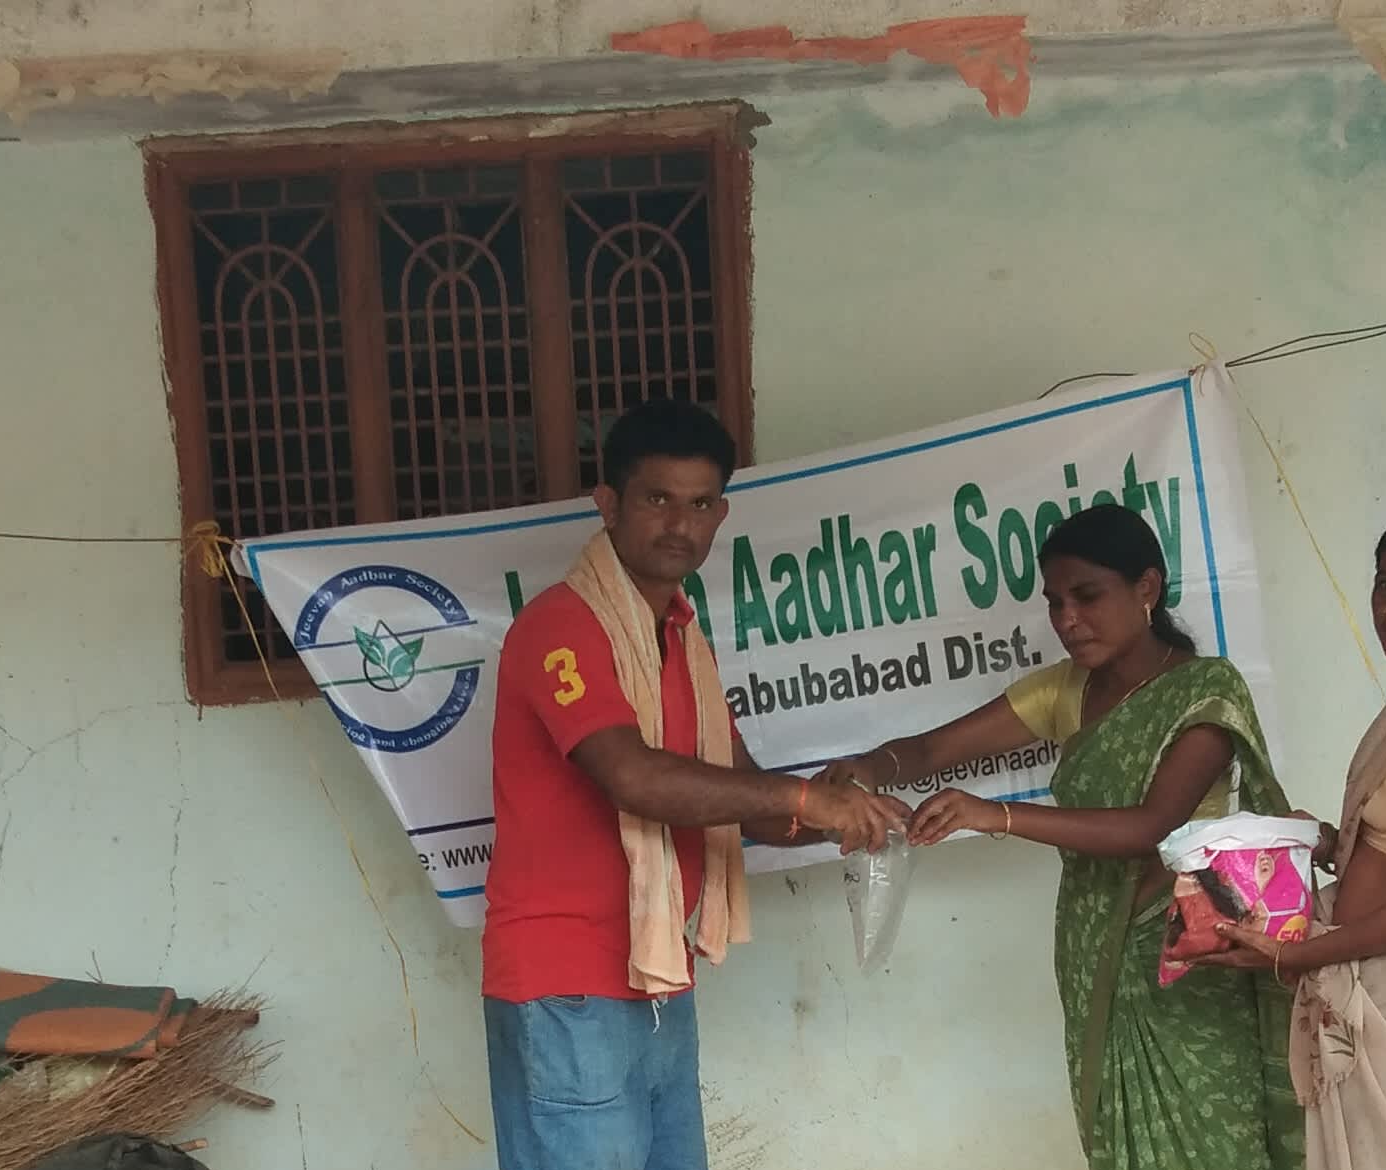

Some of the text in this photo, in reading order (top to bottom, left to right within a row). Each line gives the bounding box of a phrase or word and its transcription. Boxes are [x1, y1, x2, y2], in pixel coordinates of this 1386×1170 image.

[732, 513, 939, 652] Aadhar
[953, 451, 1182, 610] Soty
[341, 570, 397, 588] Aadhar
[405, 574, 459, 616] Society
[544, 647, 586, 706] 3
[726, 625, 1043, 719] abubabad Dist.
[441, 843, 493, 869] www
